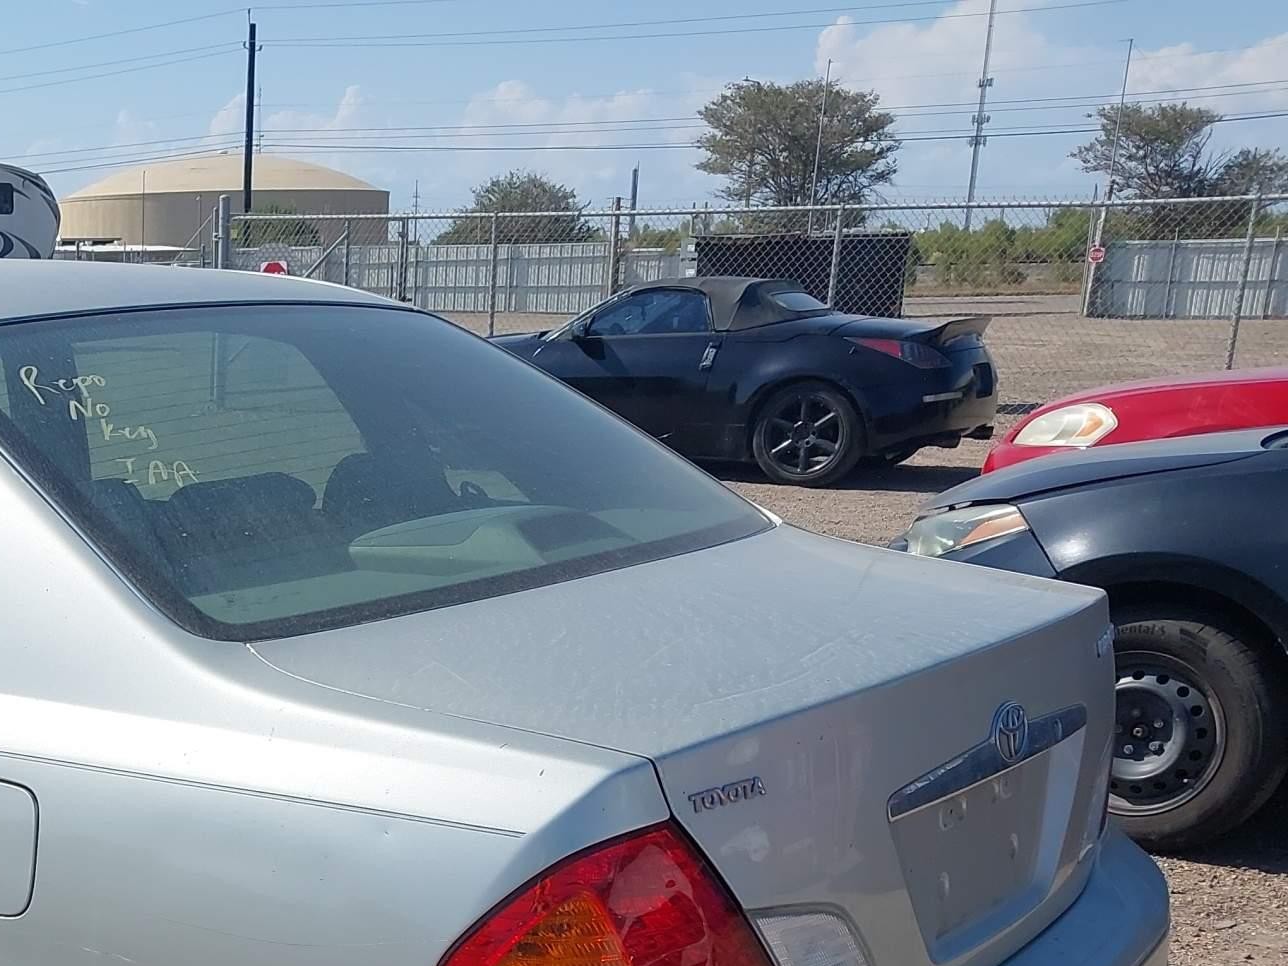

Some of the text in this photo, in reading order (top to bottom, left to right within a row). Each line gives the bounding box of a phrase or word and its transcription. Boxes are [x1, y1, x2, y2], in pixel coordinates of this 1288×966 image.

[19, 365, 106, 405] Repo
[69, 398, 111, 420] No
[688, 776, 767, 813] TOYOTA
